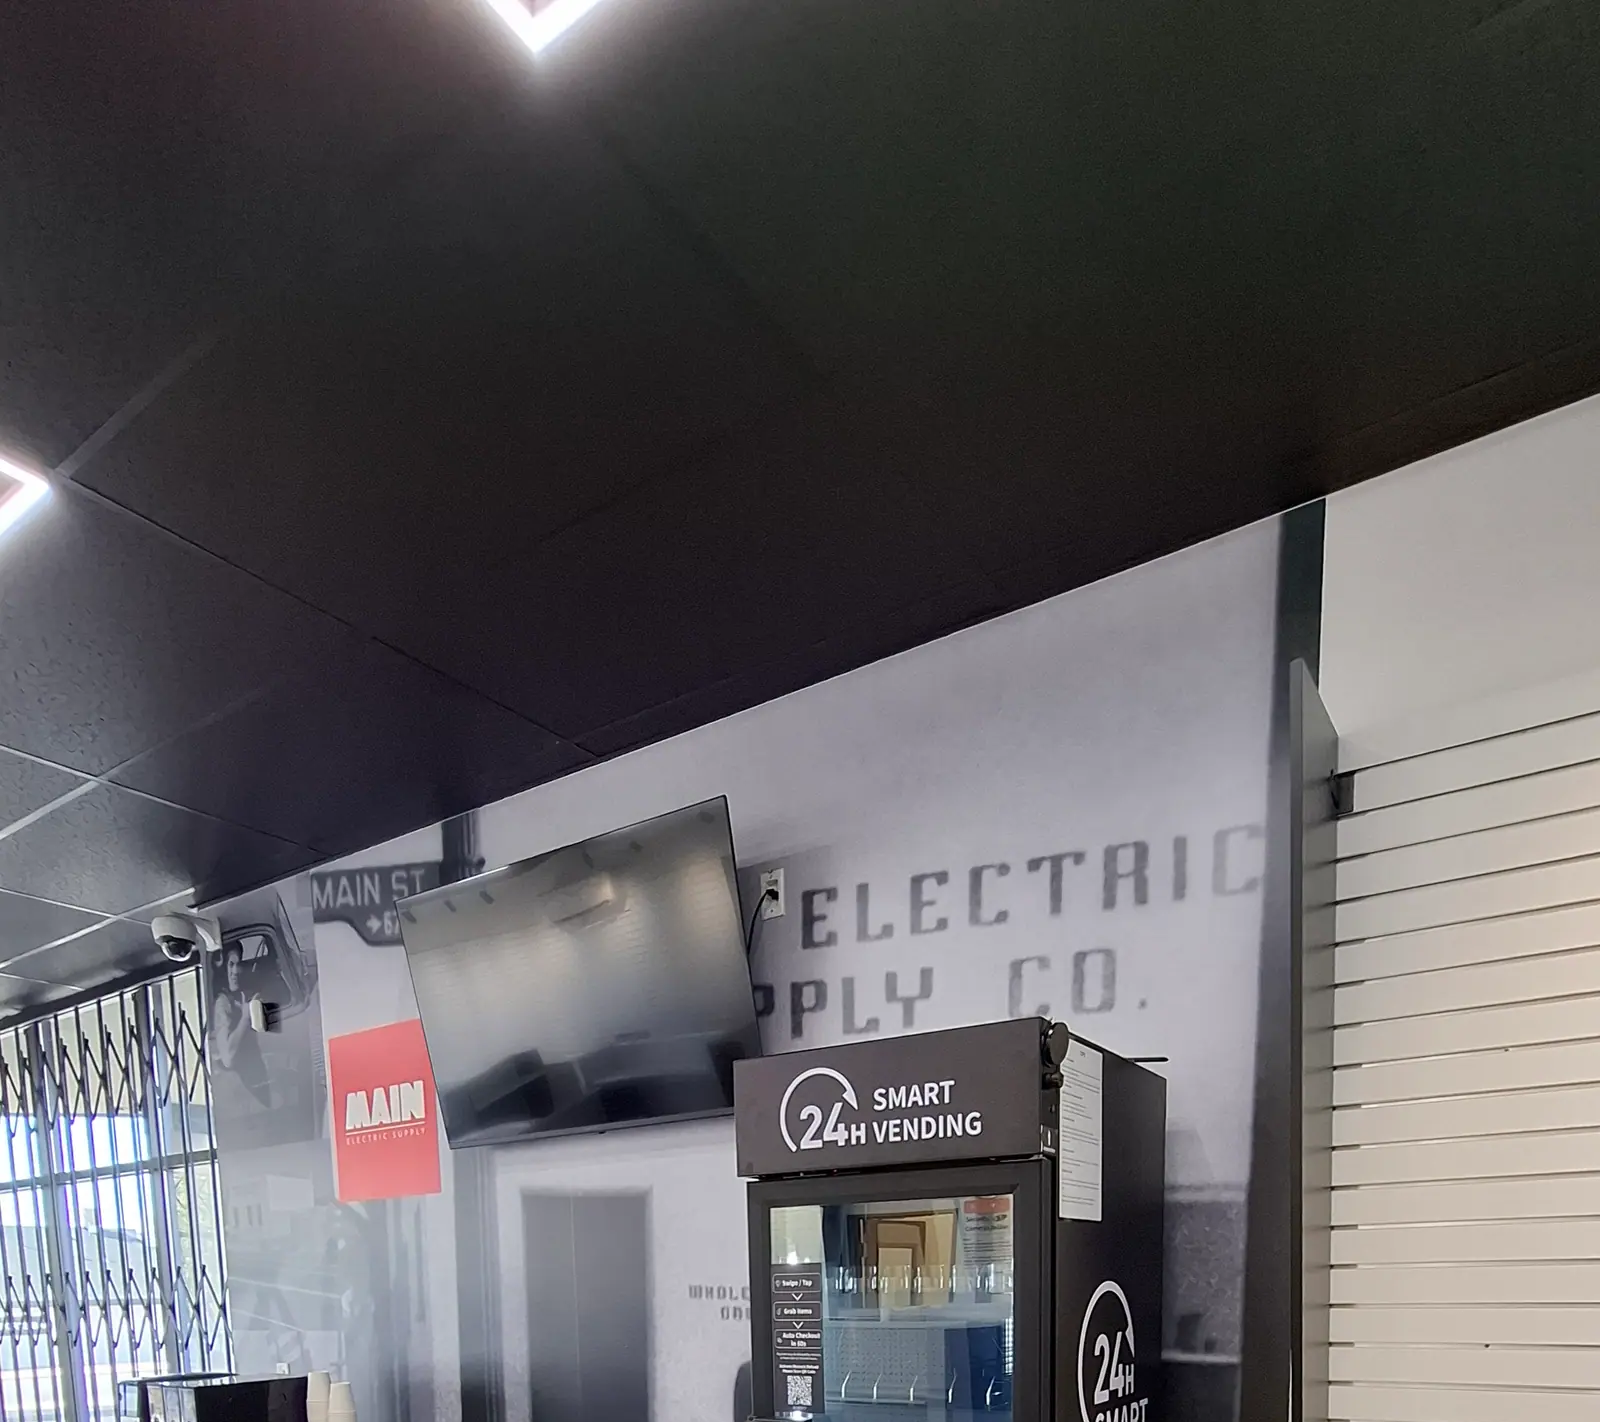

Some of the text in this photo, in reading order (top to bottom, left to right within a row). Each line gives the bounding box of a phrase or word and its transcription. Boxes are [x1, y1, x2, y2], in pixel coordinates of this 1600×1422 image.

[311, 868, 425, 910] MAIN ST
[800, 824, 1265, 950] ELECTRIC
[345, 1079, 426, 1131] MAIN
[872, 1079, 956, 1112] SMART
[346, 1127, 426, 1146] ELECTRIC SUPPLY
[799, 1101, 983, 1150] 24H VENDING
[1093, 1331, 1135, 1405] 24H
